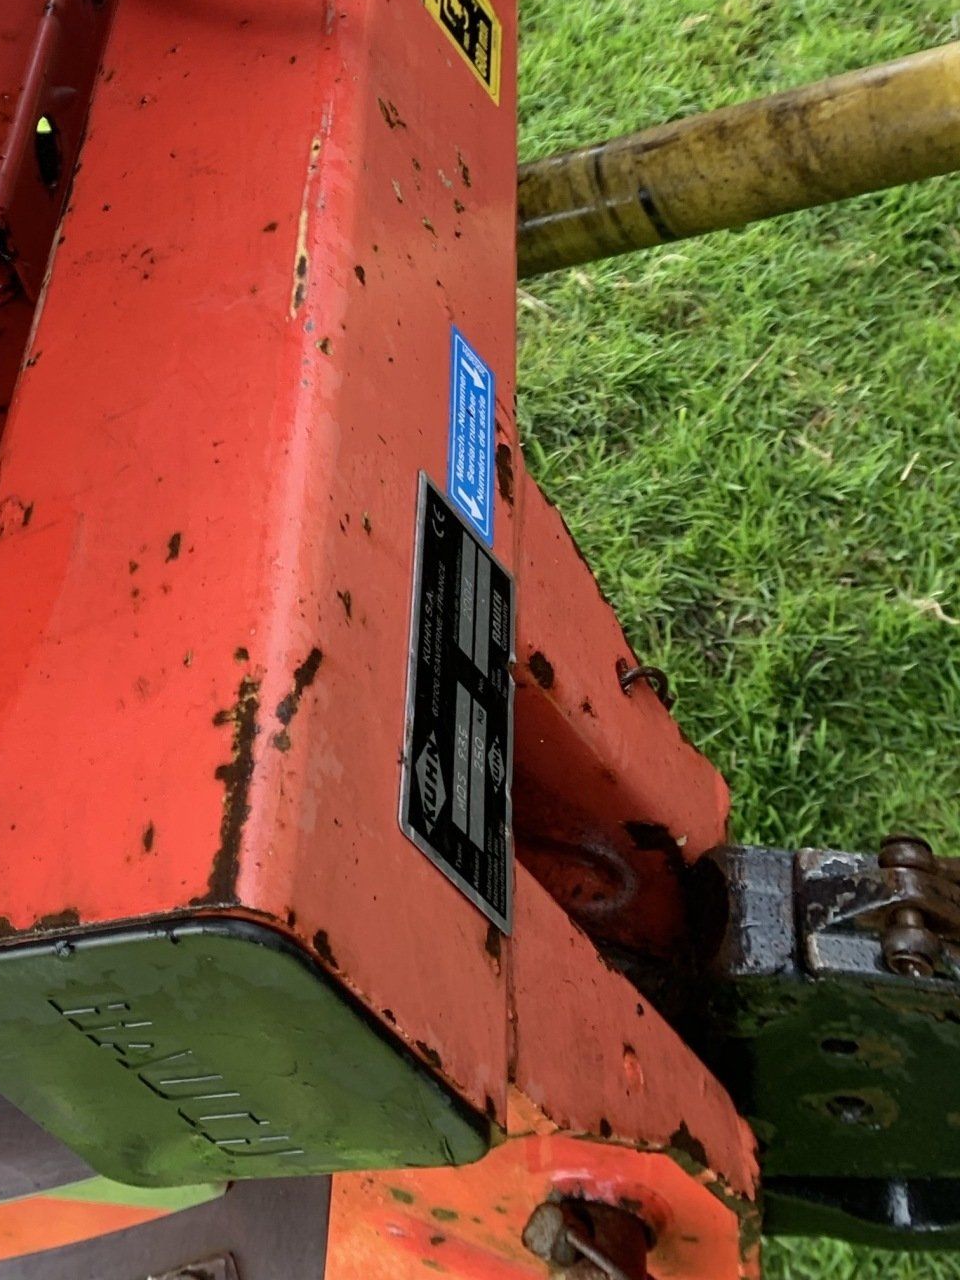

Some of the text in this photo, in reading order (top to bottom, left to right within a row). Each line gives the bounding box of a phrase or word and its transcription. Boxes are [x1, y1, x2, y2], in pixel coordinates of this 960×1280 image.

[467, 441, 475, 484] Serial
[476, 393, 486, 504] Numéro de série
[422, 590, 434, 665] KUHN S.A.
[491, 588, 503, 647] RAUCH
[422, 737, 440, 827] KUHN
[474, 734, 484, 774] 250
[456, 769, 466, 813] MDS
